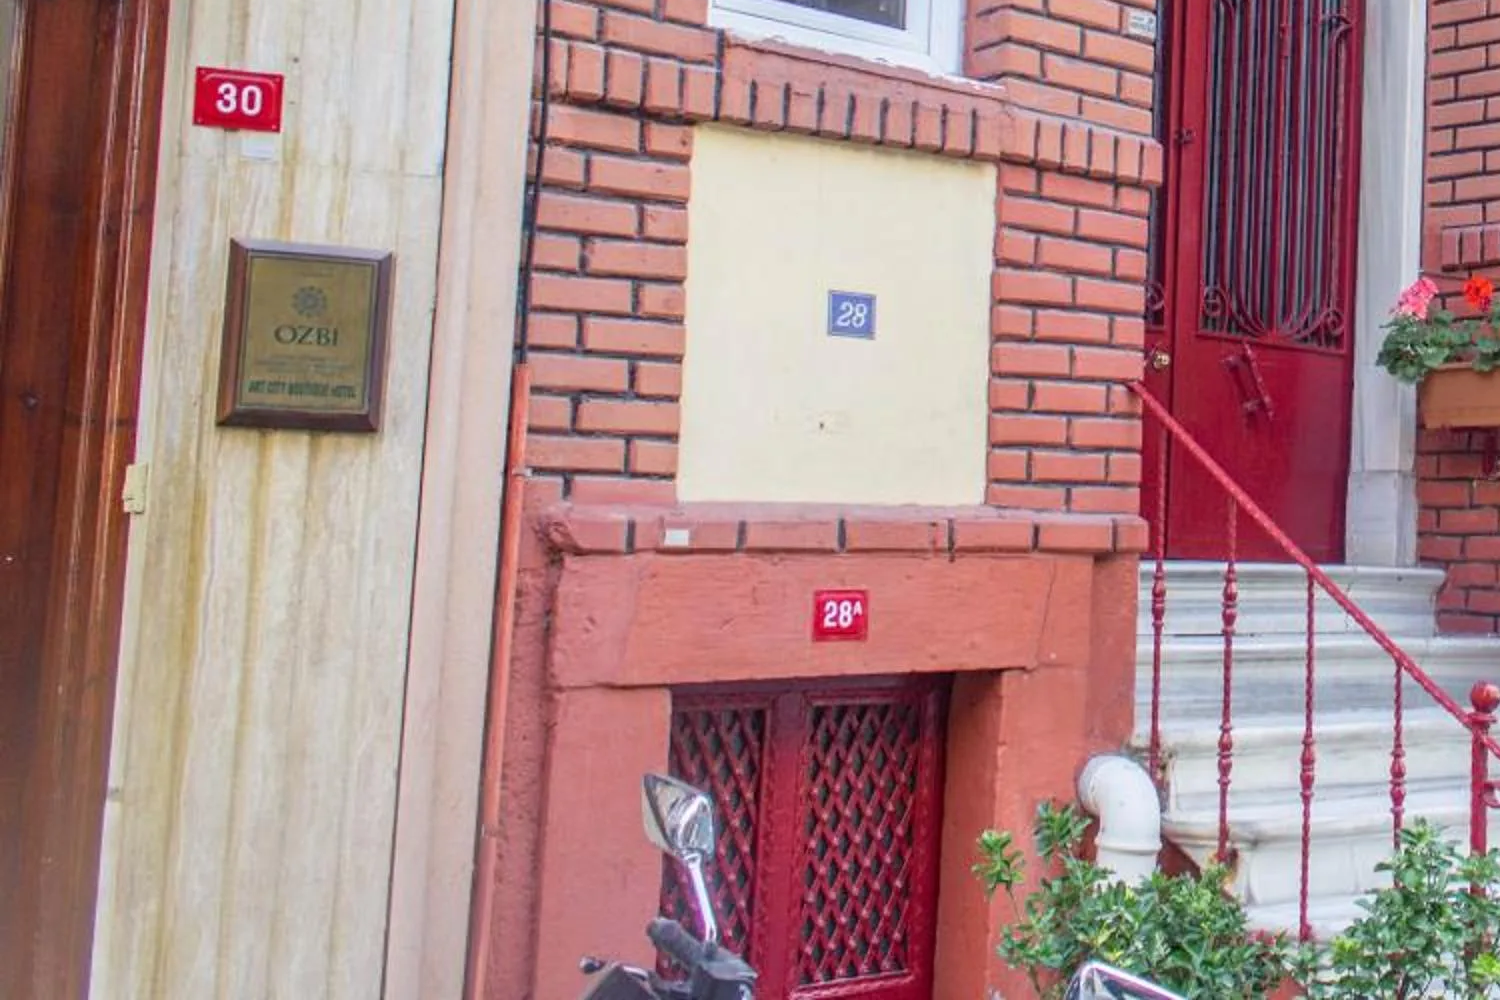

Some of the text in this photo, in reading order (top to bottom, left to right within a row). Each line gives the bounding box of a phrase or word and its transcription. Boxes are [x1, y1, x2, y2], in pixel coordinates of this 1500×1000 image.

[216, 82, 263, 117] 30
[836, 301, 868, 328] 28
[823, 599, 863, 629] 28A
